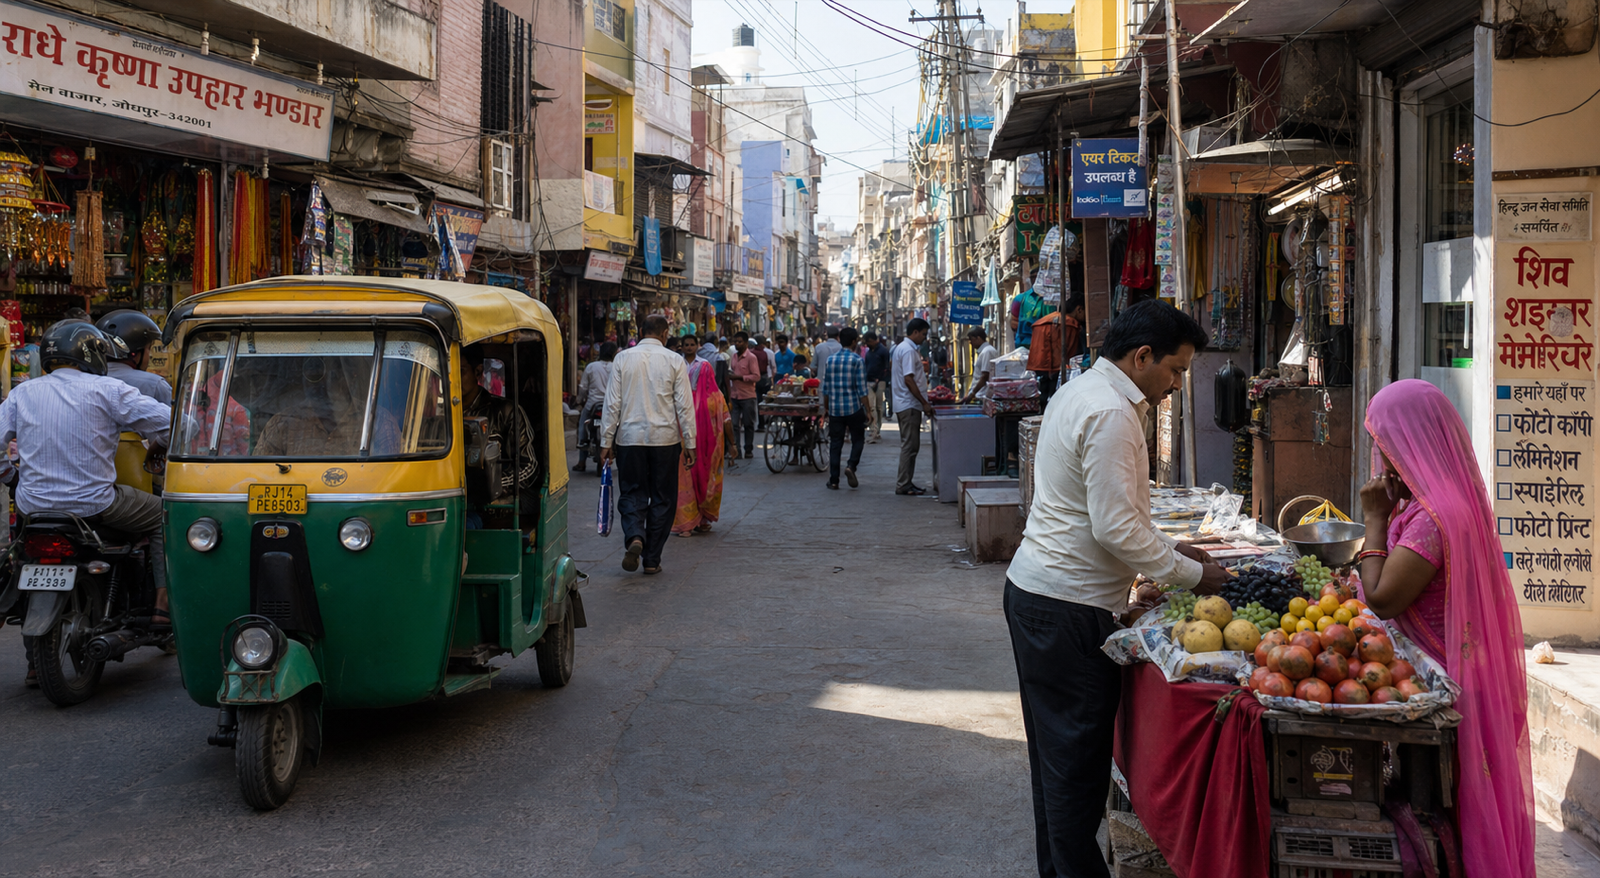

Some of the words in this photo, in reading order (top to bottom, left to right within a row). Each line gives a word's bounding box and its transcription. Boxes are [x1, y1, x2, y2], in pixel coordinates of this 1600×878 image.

[2, 21, 67, 65] राधे
[75, 41, 162, 89] कृष्णा
[168, 66, 248, 111] उपहार
[253, 89, 325, 129] भण्डार
[1080, 153, 1106, 167] एयर
[1083, 172, 1126, 183] उपलब्ध
[1127, 167, 1137, 184] है
[1498, 199, 1519, 217] हिन्दू
[1520, 202, 1538, 213] जन
[1540, 197, 1560, 213] सेवा
[1562, 197, 1589, 212] समिति
[1513, 246, 1575, 290] शिव
[1513, 381, 1544, 403] हमारे
[1545, 382, 1569, 403] यहाँ
[1570, 386, 1587, 402] पर
[264, 486, 293, 499] RJ14
[1514, 510, 1554, 538] फोटो
